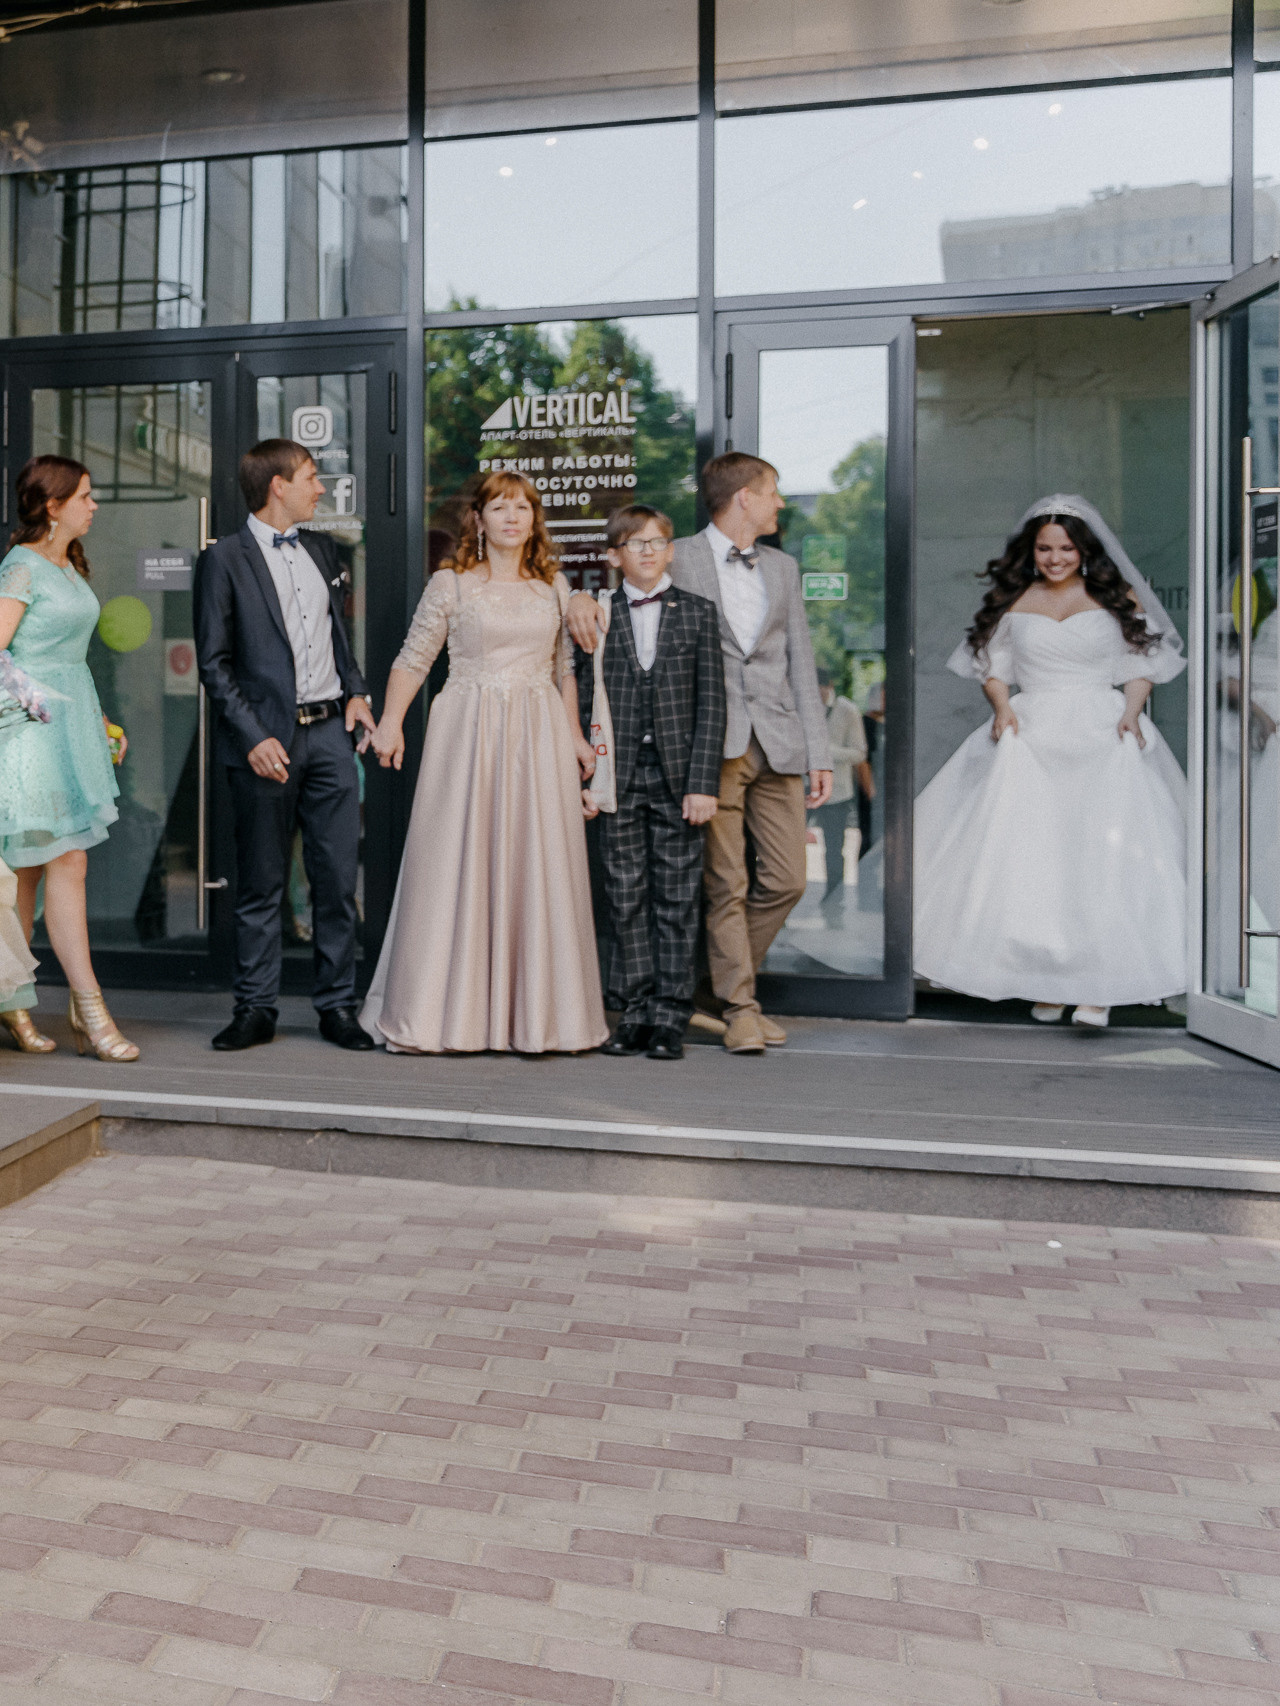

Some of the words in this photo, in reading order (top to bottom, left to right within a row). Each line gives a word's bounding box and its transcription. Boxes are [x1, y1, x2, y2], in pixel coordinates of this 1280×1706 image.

[512, 390, 638, 428] VERTICAL
[480, 428, 557, 442] АПАРТ-ОТЕЛЬ
[558, 426, 638, 440] «ВЕРТИКАЛЬ»
[479, 456, 545, 473] РЕЖИМ
[552, 453, 638, 471] РАБОТЫ:
[541, 492, 592, 508] ЕВНО
[144, 558, 159, 567] НА
[160, 557, 184, 567] СЕБЯ
